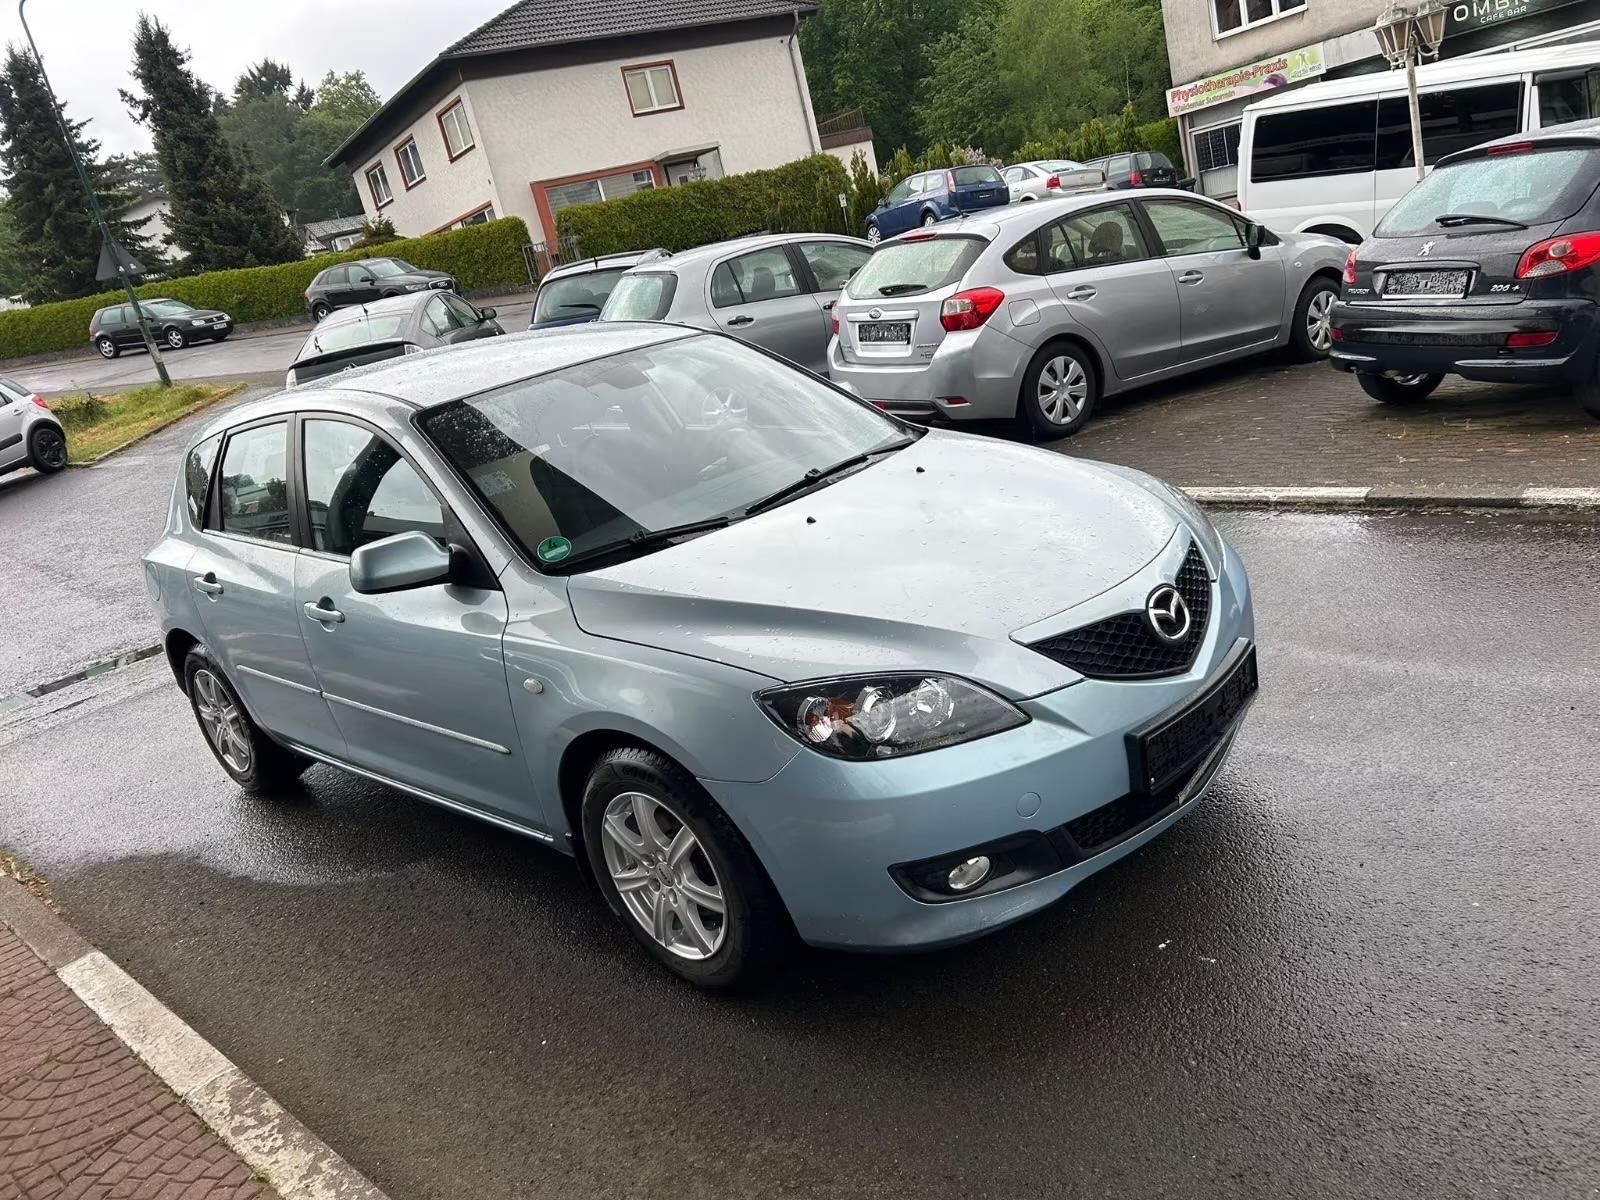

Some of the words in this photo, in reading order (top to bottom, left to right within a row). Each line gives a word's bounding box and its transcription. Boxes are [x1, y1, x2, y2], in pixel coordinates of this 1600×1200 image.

[1480, 12, 1504, 24] CAFE
[1507, 6, 1527, 17] BAR
[1490, 283, 1511, 292] 206
